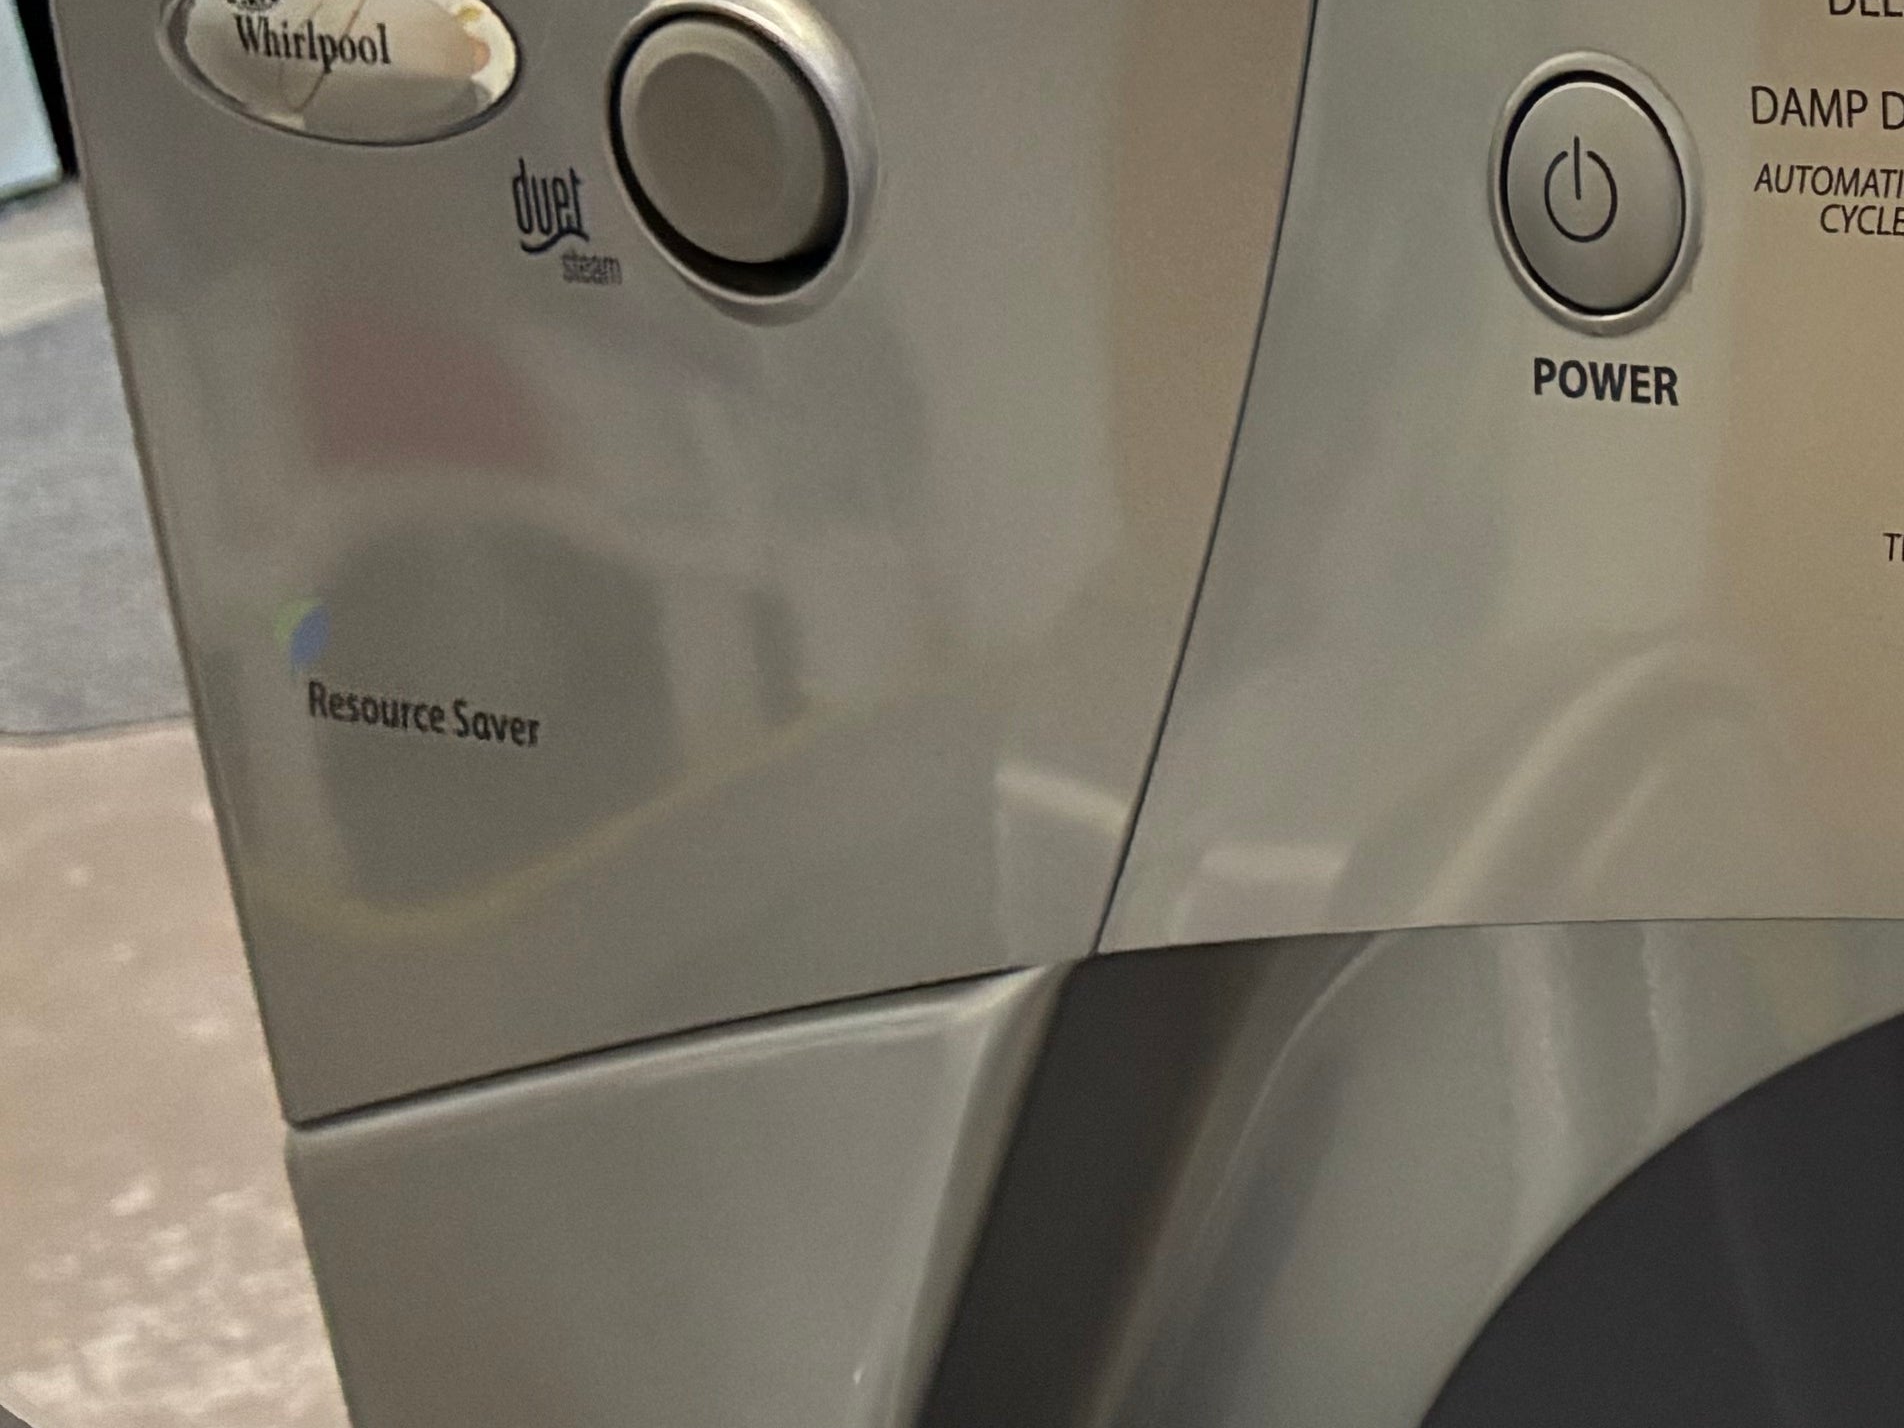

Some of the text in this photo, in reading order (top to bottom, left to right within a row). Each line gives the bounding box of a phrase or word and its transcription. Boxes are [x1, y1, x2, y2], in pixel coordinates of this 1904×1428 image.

[234, 11, 391, 72] Whirlpool
[1751, 86, 1868, 128] DAMP
[512, 158, 589, 254] duet
[1534, 358, 1678, 406] POWER
[308, 680, 539, 746] Resource Saver
